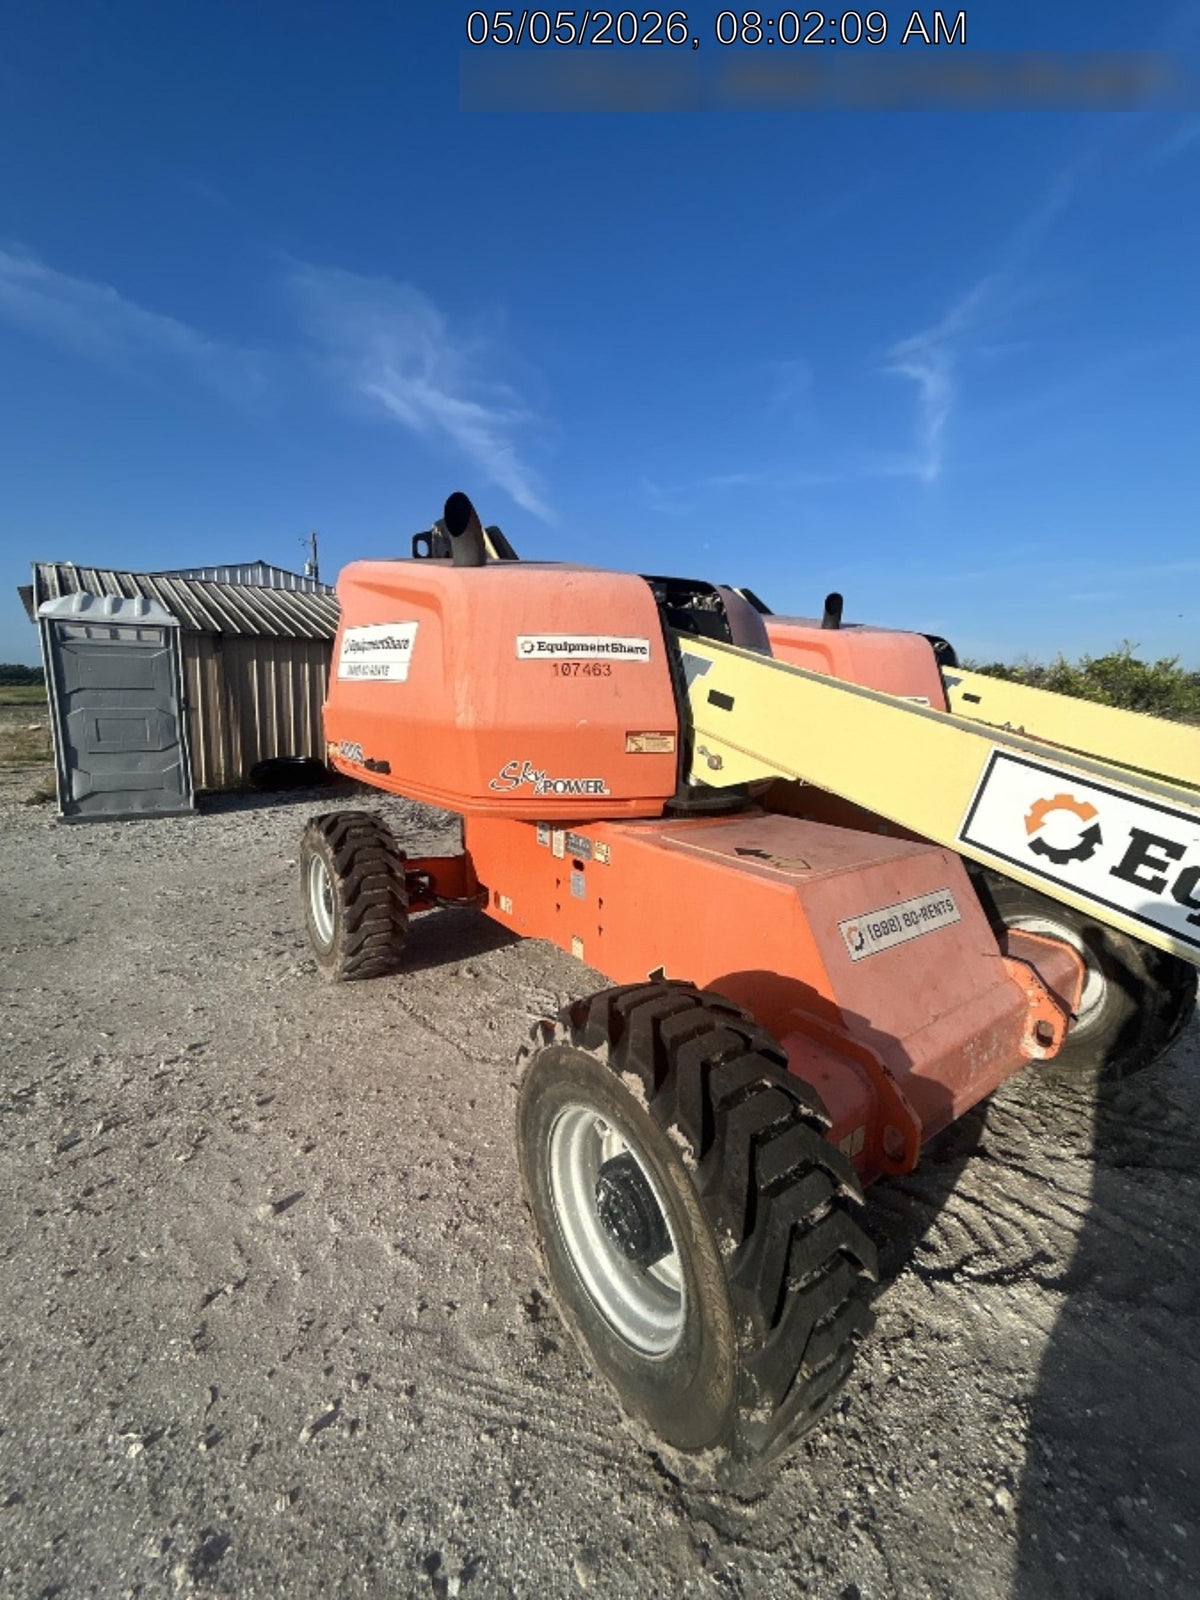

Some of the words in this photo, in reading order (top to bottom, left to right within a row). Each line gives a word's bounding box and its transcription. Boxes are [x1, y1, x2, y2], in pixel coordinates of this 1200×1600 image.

[536, 641, 648, 655] EquipmentShare
[552, 663, 612, 677] 107463
[866, 914, 903, 941] (888)
